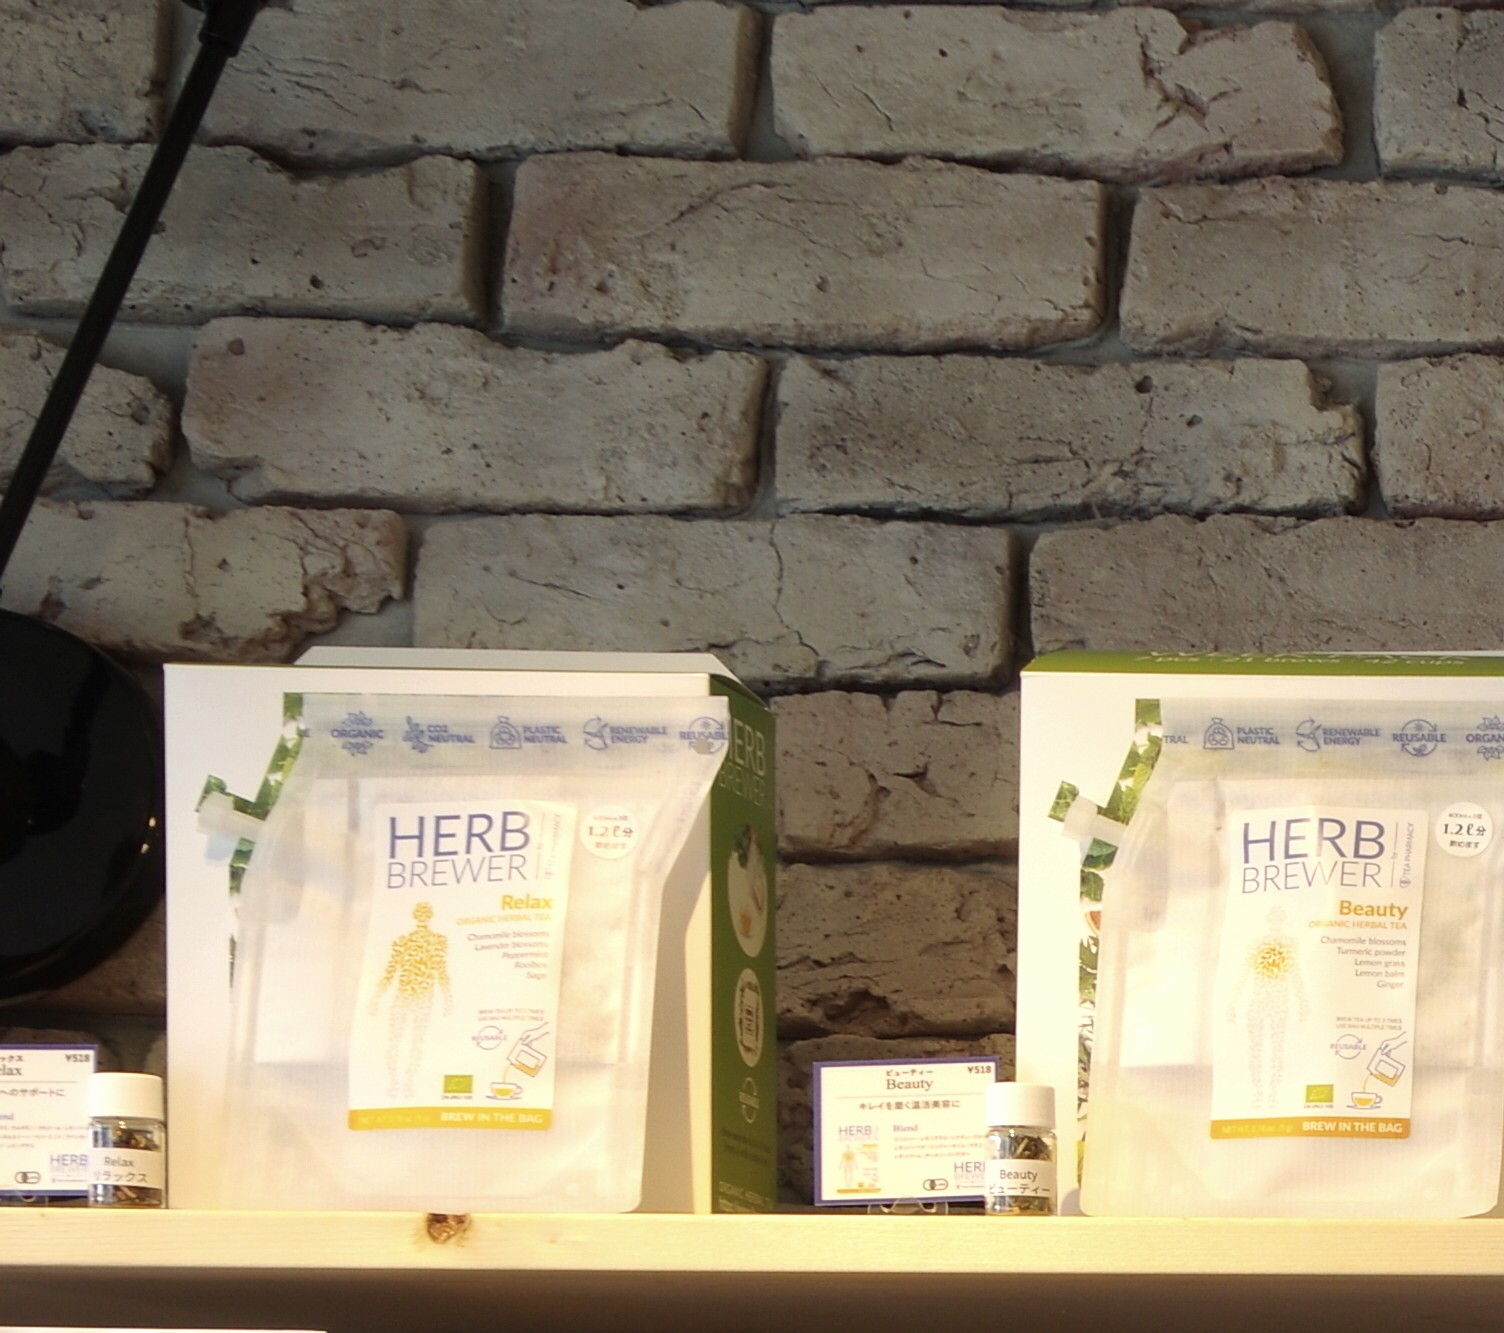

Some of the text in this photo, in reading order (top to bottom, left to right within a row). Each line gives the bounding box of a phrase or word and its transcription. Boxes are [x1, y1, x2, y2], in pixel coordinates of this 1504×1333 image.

[332, 727, 384, 739] ORGANIC
[1237, 727, 1274, 736] PLASTIC
[1323, 728, 1380, 738] RENEWABLE
[611, 734, 648, 744] ENERGY
[1237, 735, 1280, 745] NEUTRAL
[1324, 737, 1361, 746] ENERGY
[1392, 732, 1446, 743] REUSABLE
[388, 810, 530, 860] HERB
[1243, 817, 1385, 863] HERB
[386, 855, 528, 888] BREWER
[1242, 860, 1382, 893] BREWER
[501, 895, 552, 911] Relax
[1339, 899, 1408, 920] Beauty
[1321, 936, 1406, 945] Chamomile blossoms
[886, 1079, 933, 1091] Beauty
[1303, 1122, 1336, 1131] BREW
[1339, 1123, 1351, 1131] IN
[1354, 1123, 1376, 1132] THE
[1379, 1123, 1402, 1133] BAG
[104, 1157, 134, 1166] Relax
[1000, 1169, 1038, 1181] Beauty
